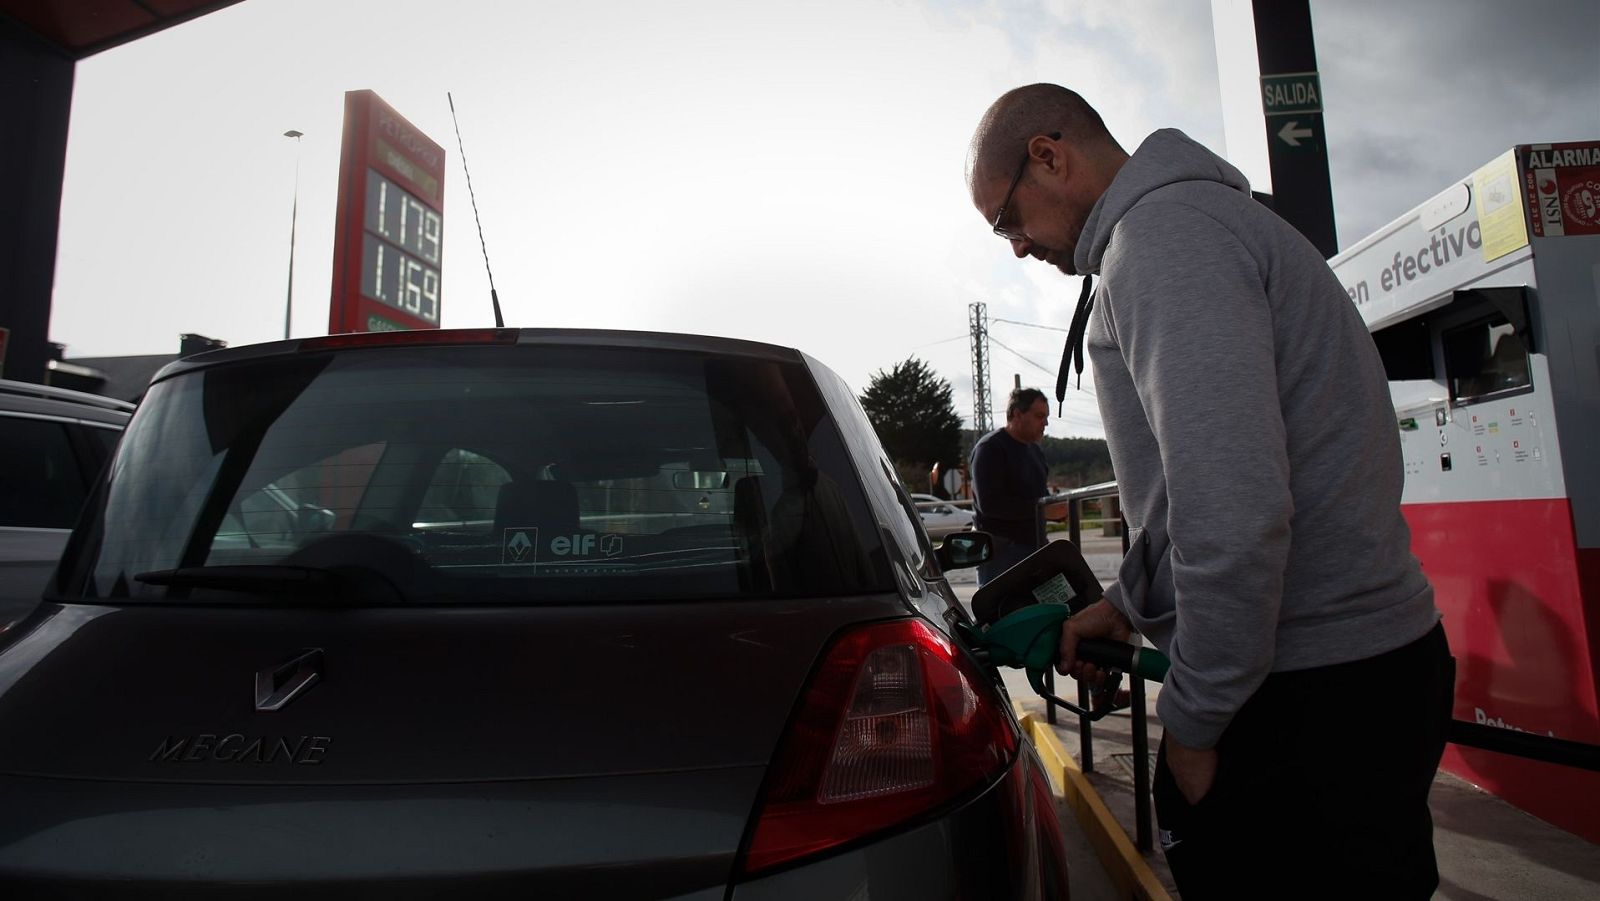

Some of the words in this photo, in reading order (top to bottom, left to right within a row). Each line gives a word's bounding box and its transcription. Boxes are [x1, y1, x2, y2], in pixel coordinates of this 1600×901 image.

[1264, 82, 1318, 106] SALIDA
[1529, 148, 1600, 168] ALARMA
[378, 181, 440, 264] 1.179
[1544, 197, 1562, 227] NST
[1349, 281, 1370, 306] en
[1381, 220, 1482, 292] efectivo
[375, 244, 440, 321] 1.169
[550, 534, 596, 556] elf
[148, 733, 331, 765] MEGANE
